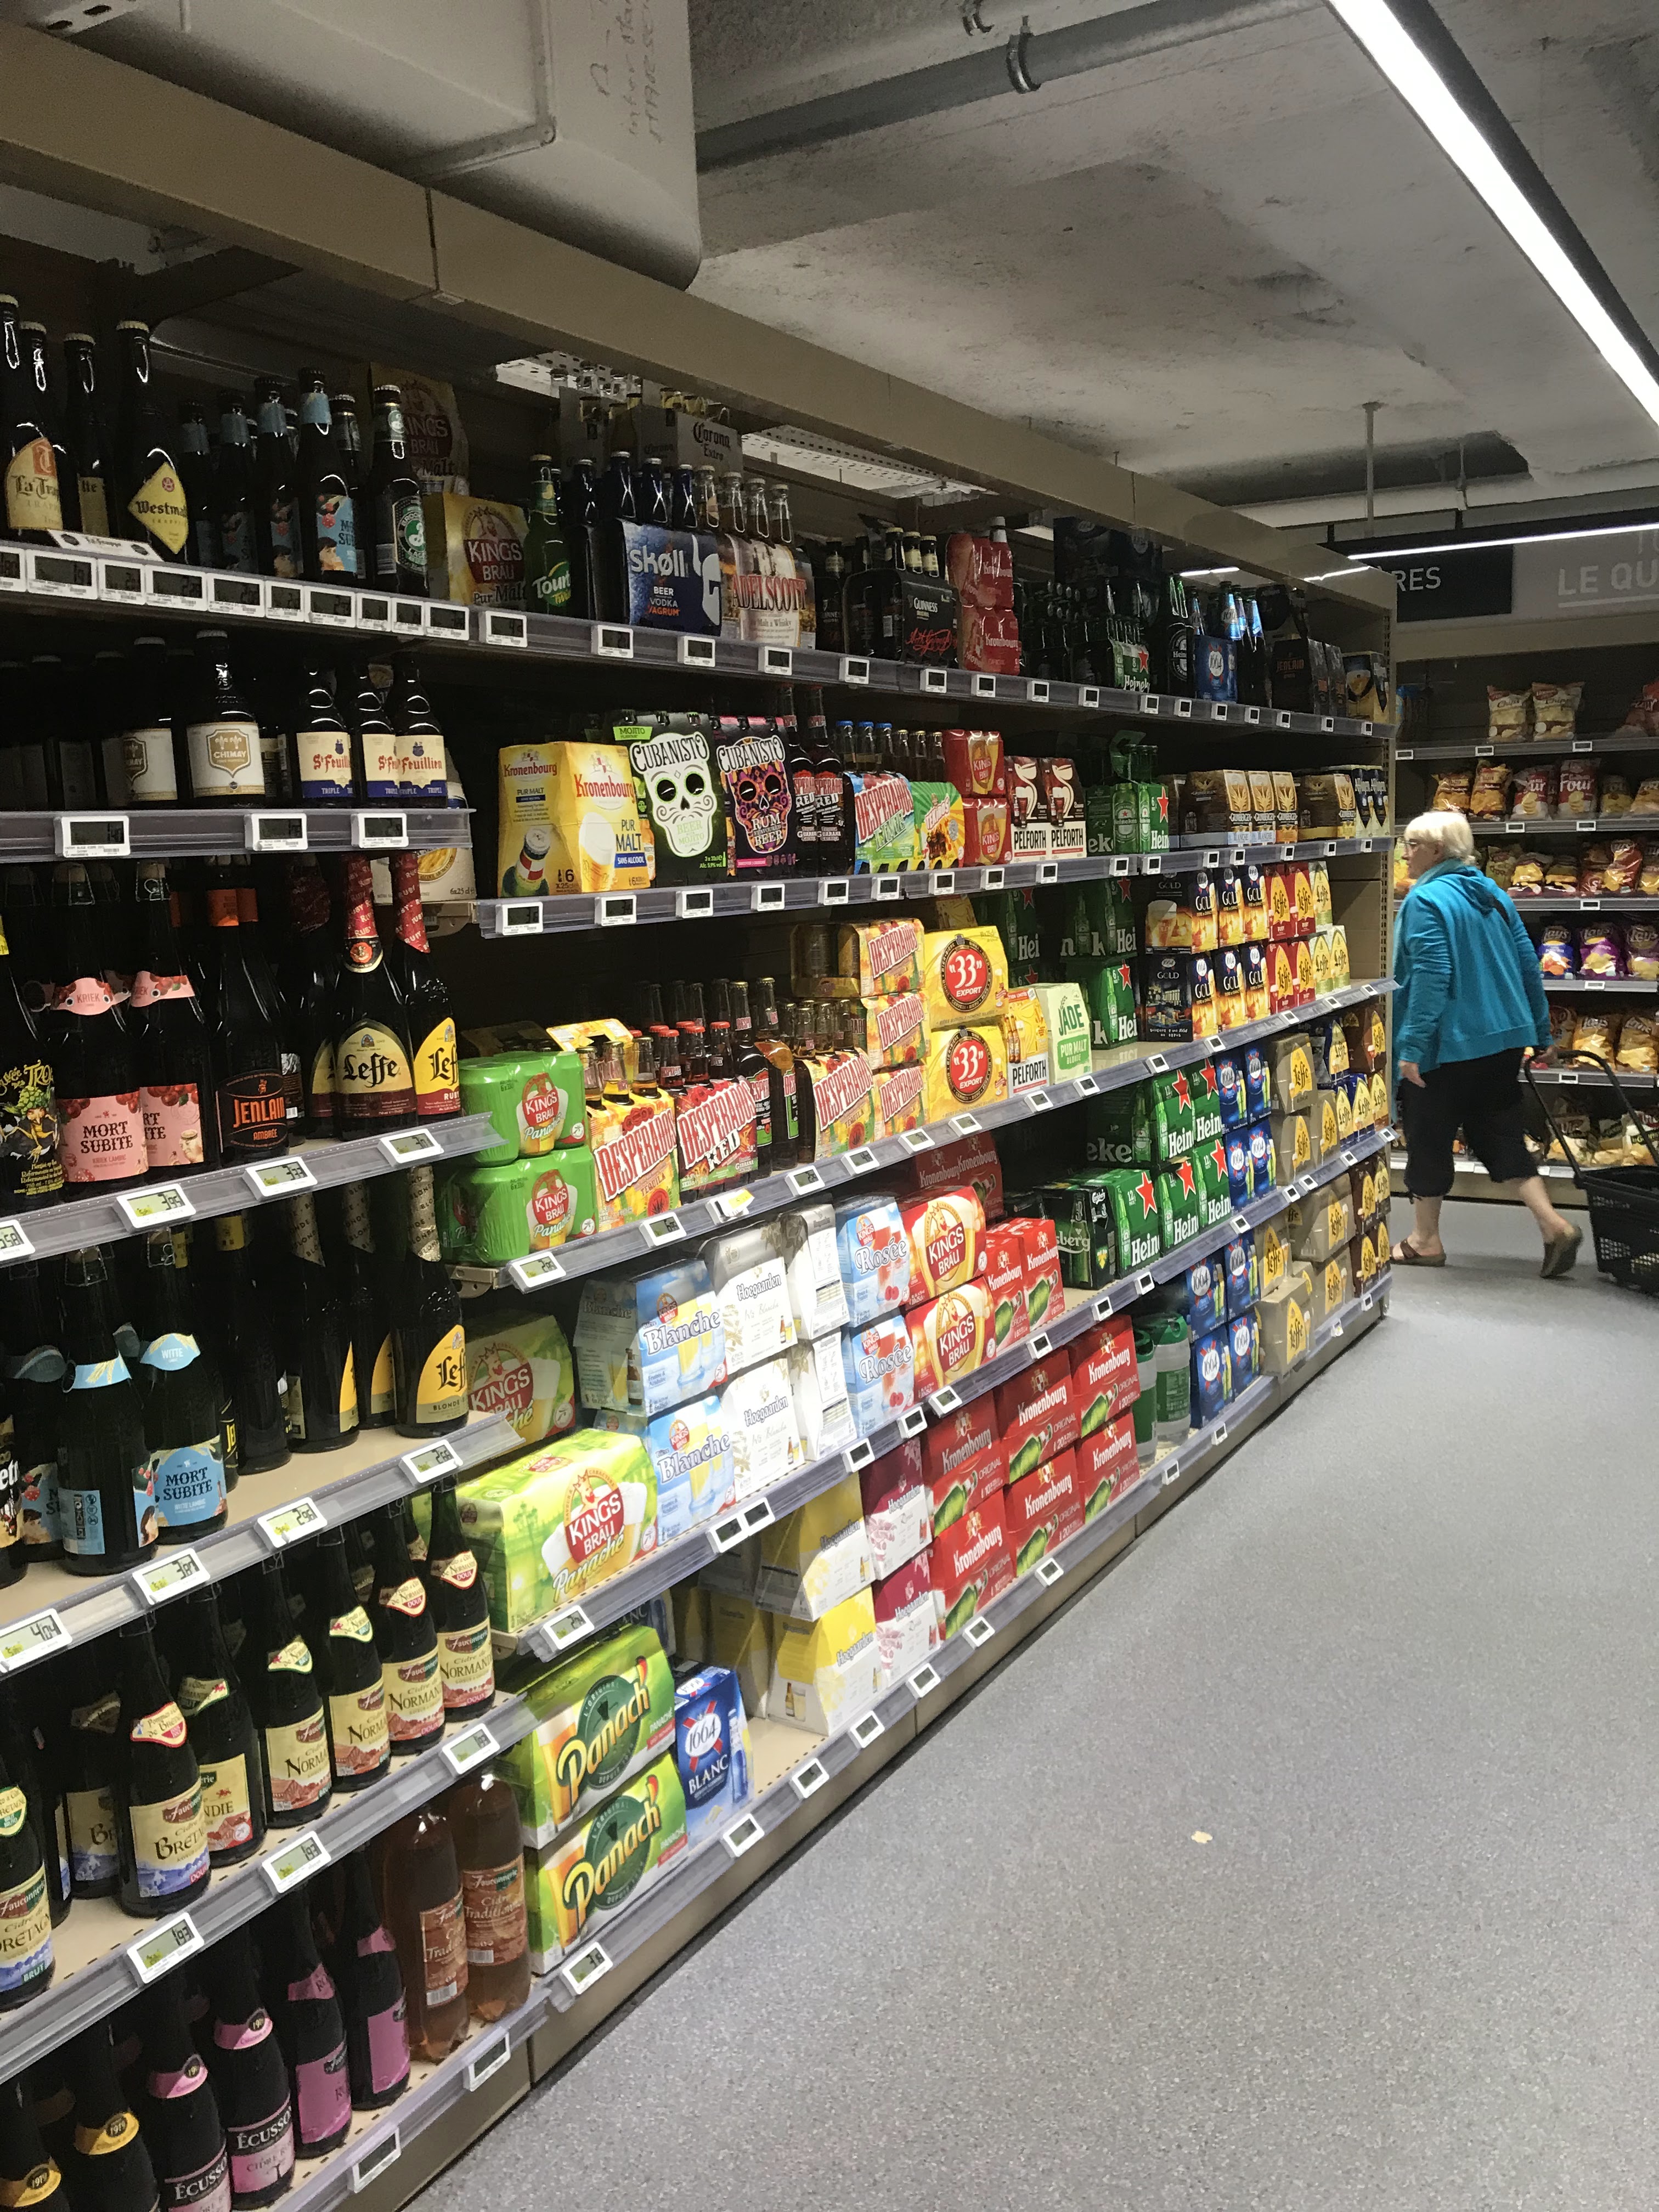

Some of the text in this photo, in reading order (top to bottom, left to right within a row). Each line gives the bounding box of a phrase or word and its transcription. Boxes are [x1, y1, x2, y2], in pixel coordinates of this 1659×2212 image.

[653, 586, 674, 596] BEER
[1395, 567, 1442, 592] RES
[1558, 566, 1599, 596] LE
[650, 599, 678, 608] VODKA
[213, 749, 246, 759] CHIMAY
[631, 733, 708, 772] CUBANISTO
[717, 735, 786, 771] CUBANISTO
[573, 774, 637, 805] Kronenbourg
[621, 819, 636, 832] PUR
[1013, 829, 1047, 850] PELFORTH
[1051, 827, 1085, 848] PELFORTH
[616, 833, 642, 851] MALT
[77, 992, 100, 1004] KRIEK
[955, 985, 982, 998] EXPORT
[1058, 1003, 1085, 1037] JADE
[342, 1052, 402, 1090] Leffe
[959, 1076, 983, 1088] EXPORT
[1012, 1060, 1047, 1087] PELFORTH
[82, 1120, 128, 1139] MORT
[678, 1080, 755, 1170] DESPERADOS
[80, 1135, 134, 1154] SUBITE
[535, 1187, 568, 1214] KINGS
[854, 1234, 907, 1273] Rosée
[928, 1223, 965, 1265] KINGS
[736, 1273, 782, 1302] Hoegaarden
[644, 1310, 722, 1357] Blanche
[939, 1313, 975, 1355] KINGS
[161, 1347, 184, 1359] WITTE
[859, 1341, 912, 1384] Rosée
[1088, 1349, 1131, 1385] Kronenbourg
[744, 1395, 789, 1427] Hoegaarden
[1018, 1383, 1068, 1427] Kronenbourg
[658, 1432, 731, 1484] Blanche
[942, 1426, 992, 1472] Kronenbourg
[1093, 1430, 1132, 1471] Kronenbourg
[162, 1480, 213, 1502] SUBITE
[165, 1466, 208, 1485] MORT
[1024, 1472, 1074, 1521] Kronenbourg
[567, 1491, 622, 1543] KINGS
[582, 1523, 617, 1559] BRÄU
[953, 1522, 1003, 1578] Kronenbourg
[552, 1533, 626, 1600] Panaché
[686, 1716, 720, 1750] 1664
[687, 1756, 730, 1794] BLANC
[22, 1963, 47, 1982] BRUT
